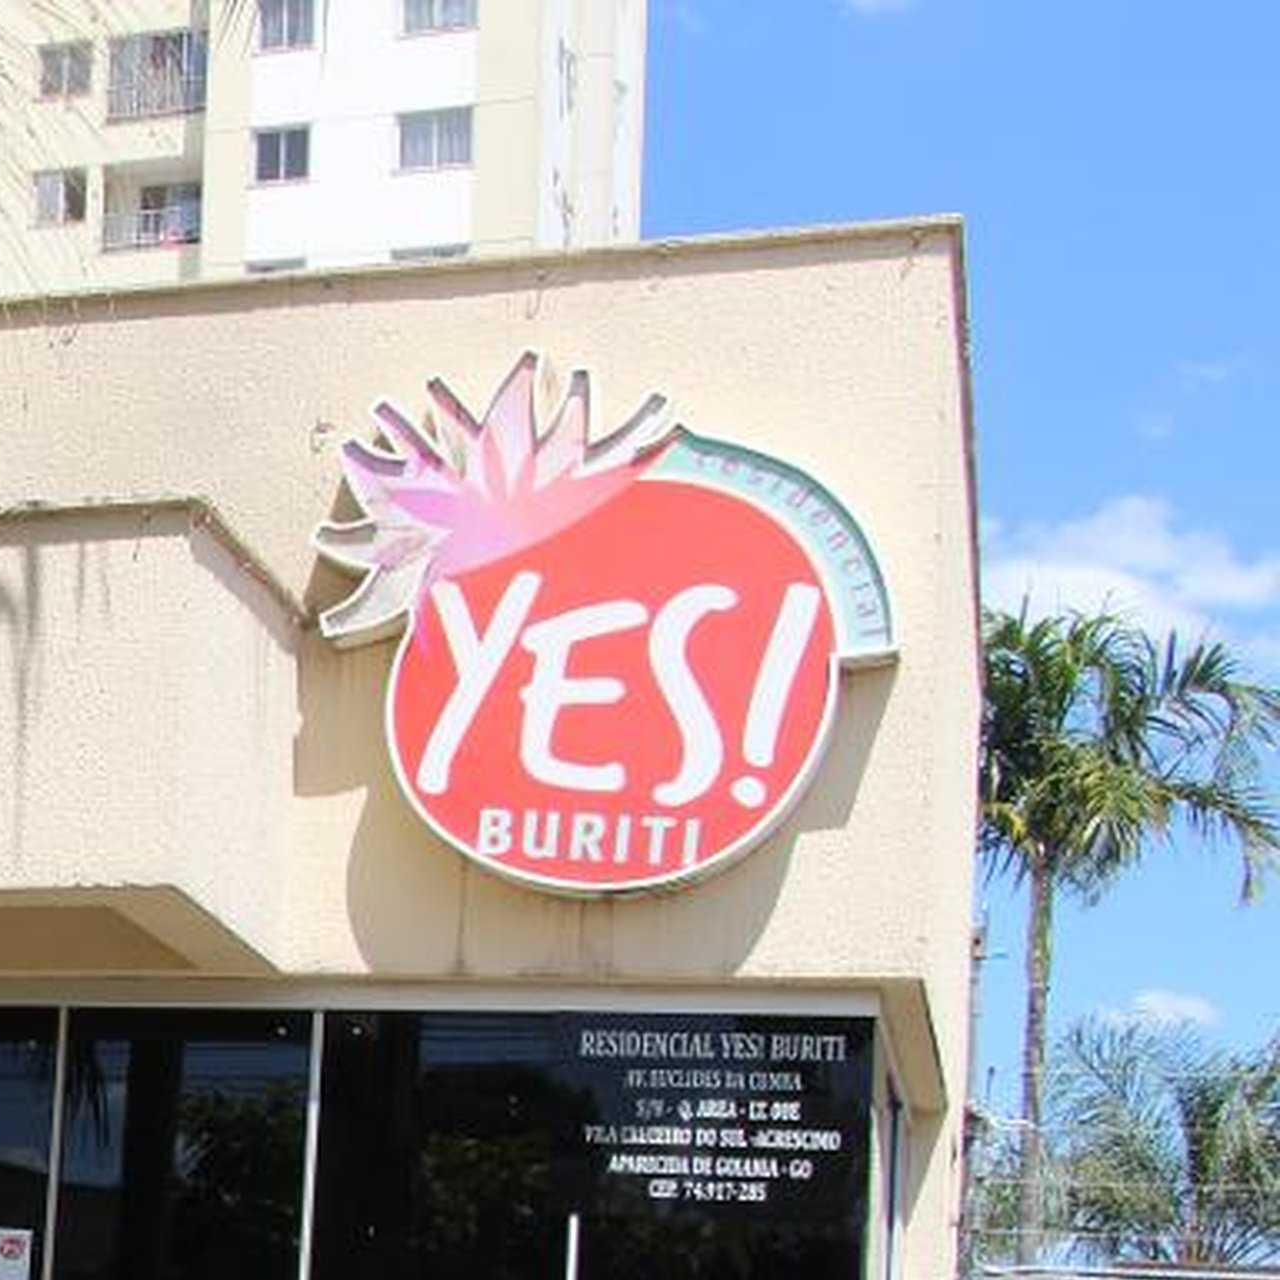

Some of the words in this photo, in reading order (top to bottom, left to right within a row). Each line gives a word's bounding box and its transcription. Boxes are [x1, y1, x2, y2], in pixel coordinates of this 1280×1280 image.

[416, 571, 821, 809] YES!
[478, 806, 701, 867] BURITI
[580, 1030, 715, 1059] RESIDENCIAL
[770, 1034, 846, 1061] BURITI
